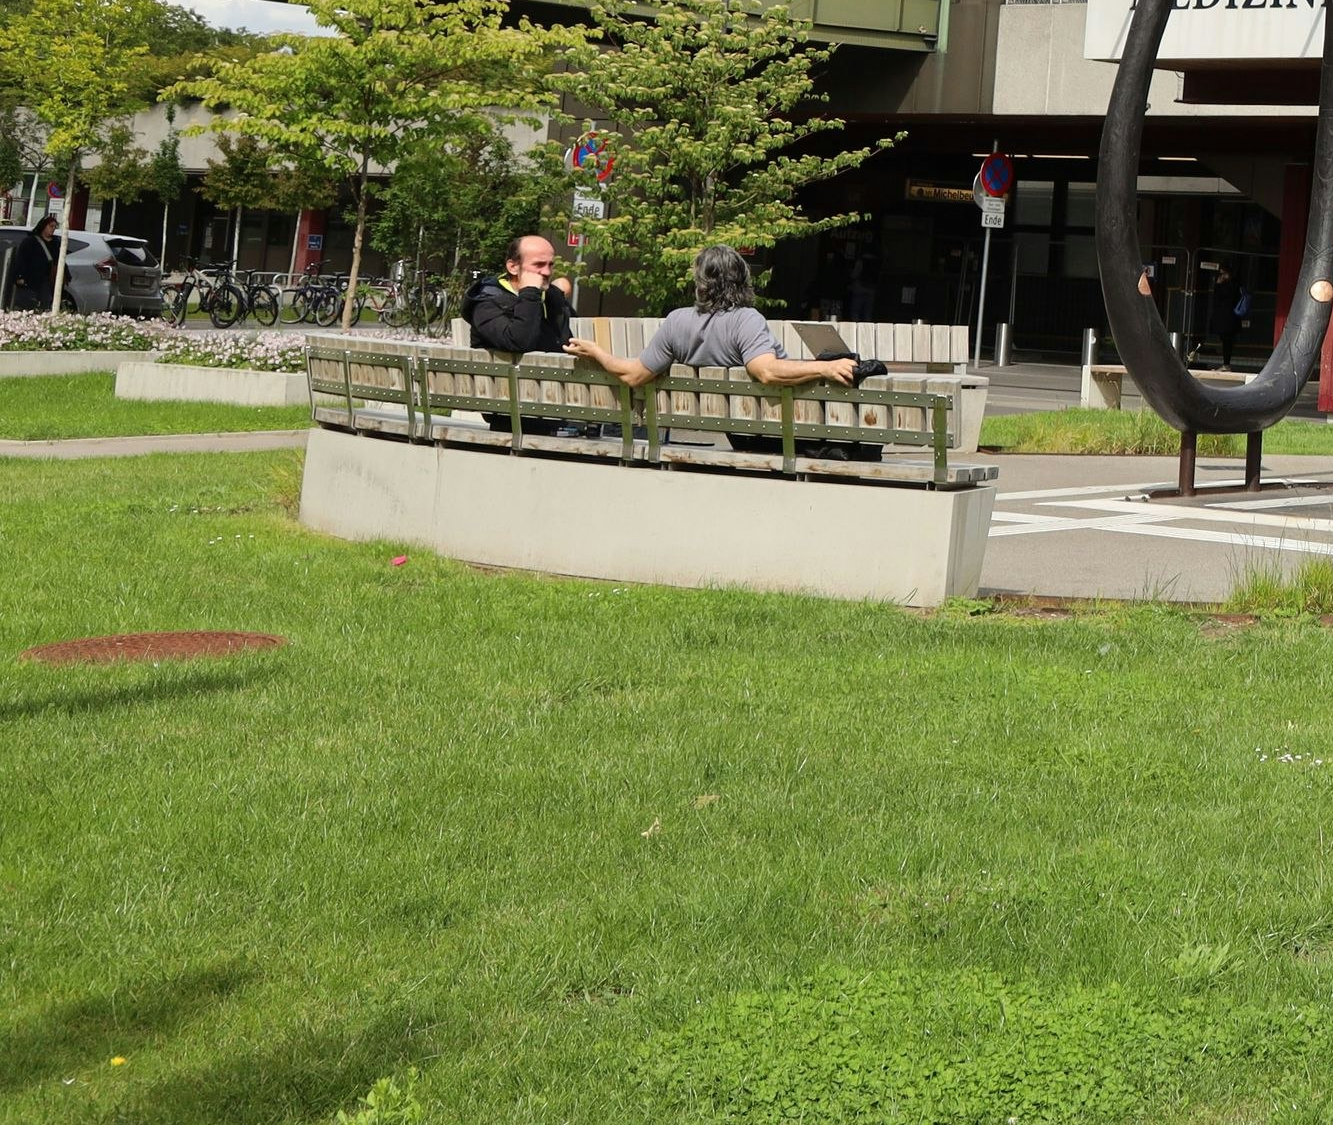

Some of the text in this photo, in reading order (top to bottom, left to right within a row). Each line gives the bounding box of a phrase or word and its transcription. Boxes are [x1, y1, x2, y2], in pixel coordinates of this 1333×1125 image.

[933, 187, 974, 202] Michelbeu
[576, 202, 601, 217] Ende
[984, 214, 1002, 226] Ende
